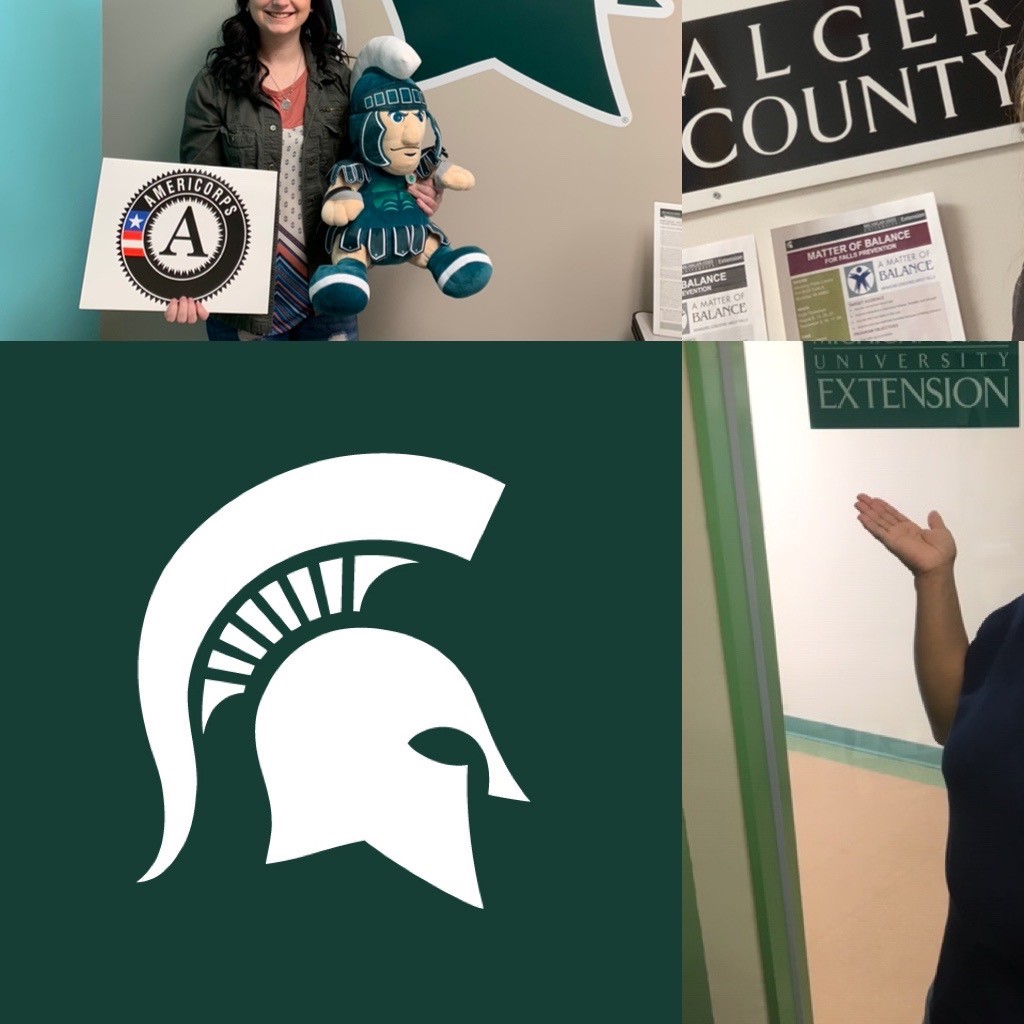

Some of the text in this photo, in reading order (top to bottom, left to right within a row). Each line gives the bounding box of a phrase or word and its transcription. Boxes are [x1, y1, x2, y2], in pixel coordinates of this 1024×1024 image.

[682, 43, 1017, 169] COUNTY
[143, 177, 238, 217] AMERICORPS
[158, 205, 209, 258] A
[807, 229, 911, 262] MATTER OF BALANCE
[824, 243, 897, 264] FOR FALLS PREVENTION
[886, 252, 916, 266] MATTER
[919, 249, 930, 259] OF
[682, 271, 728, 290] BALANCE
[879, 259, 935, 282] BALANCE
[700, 295, 731, 308] MATTER
[733, 292, 744, 302] OF
[692, 302, 748, 323] BALANCE
[813, 351, 1009, 370] UNIVERSITY
[817, 375, 1009, 409] EXTENSION
